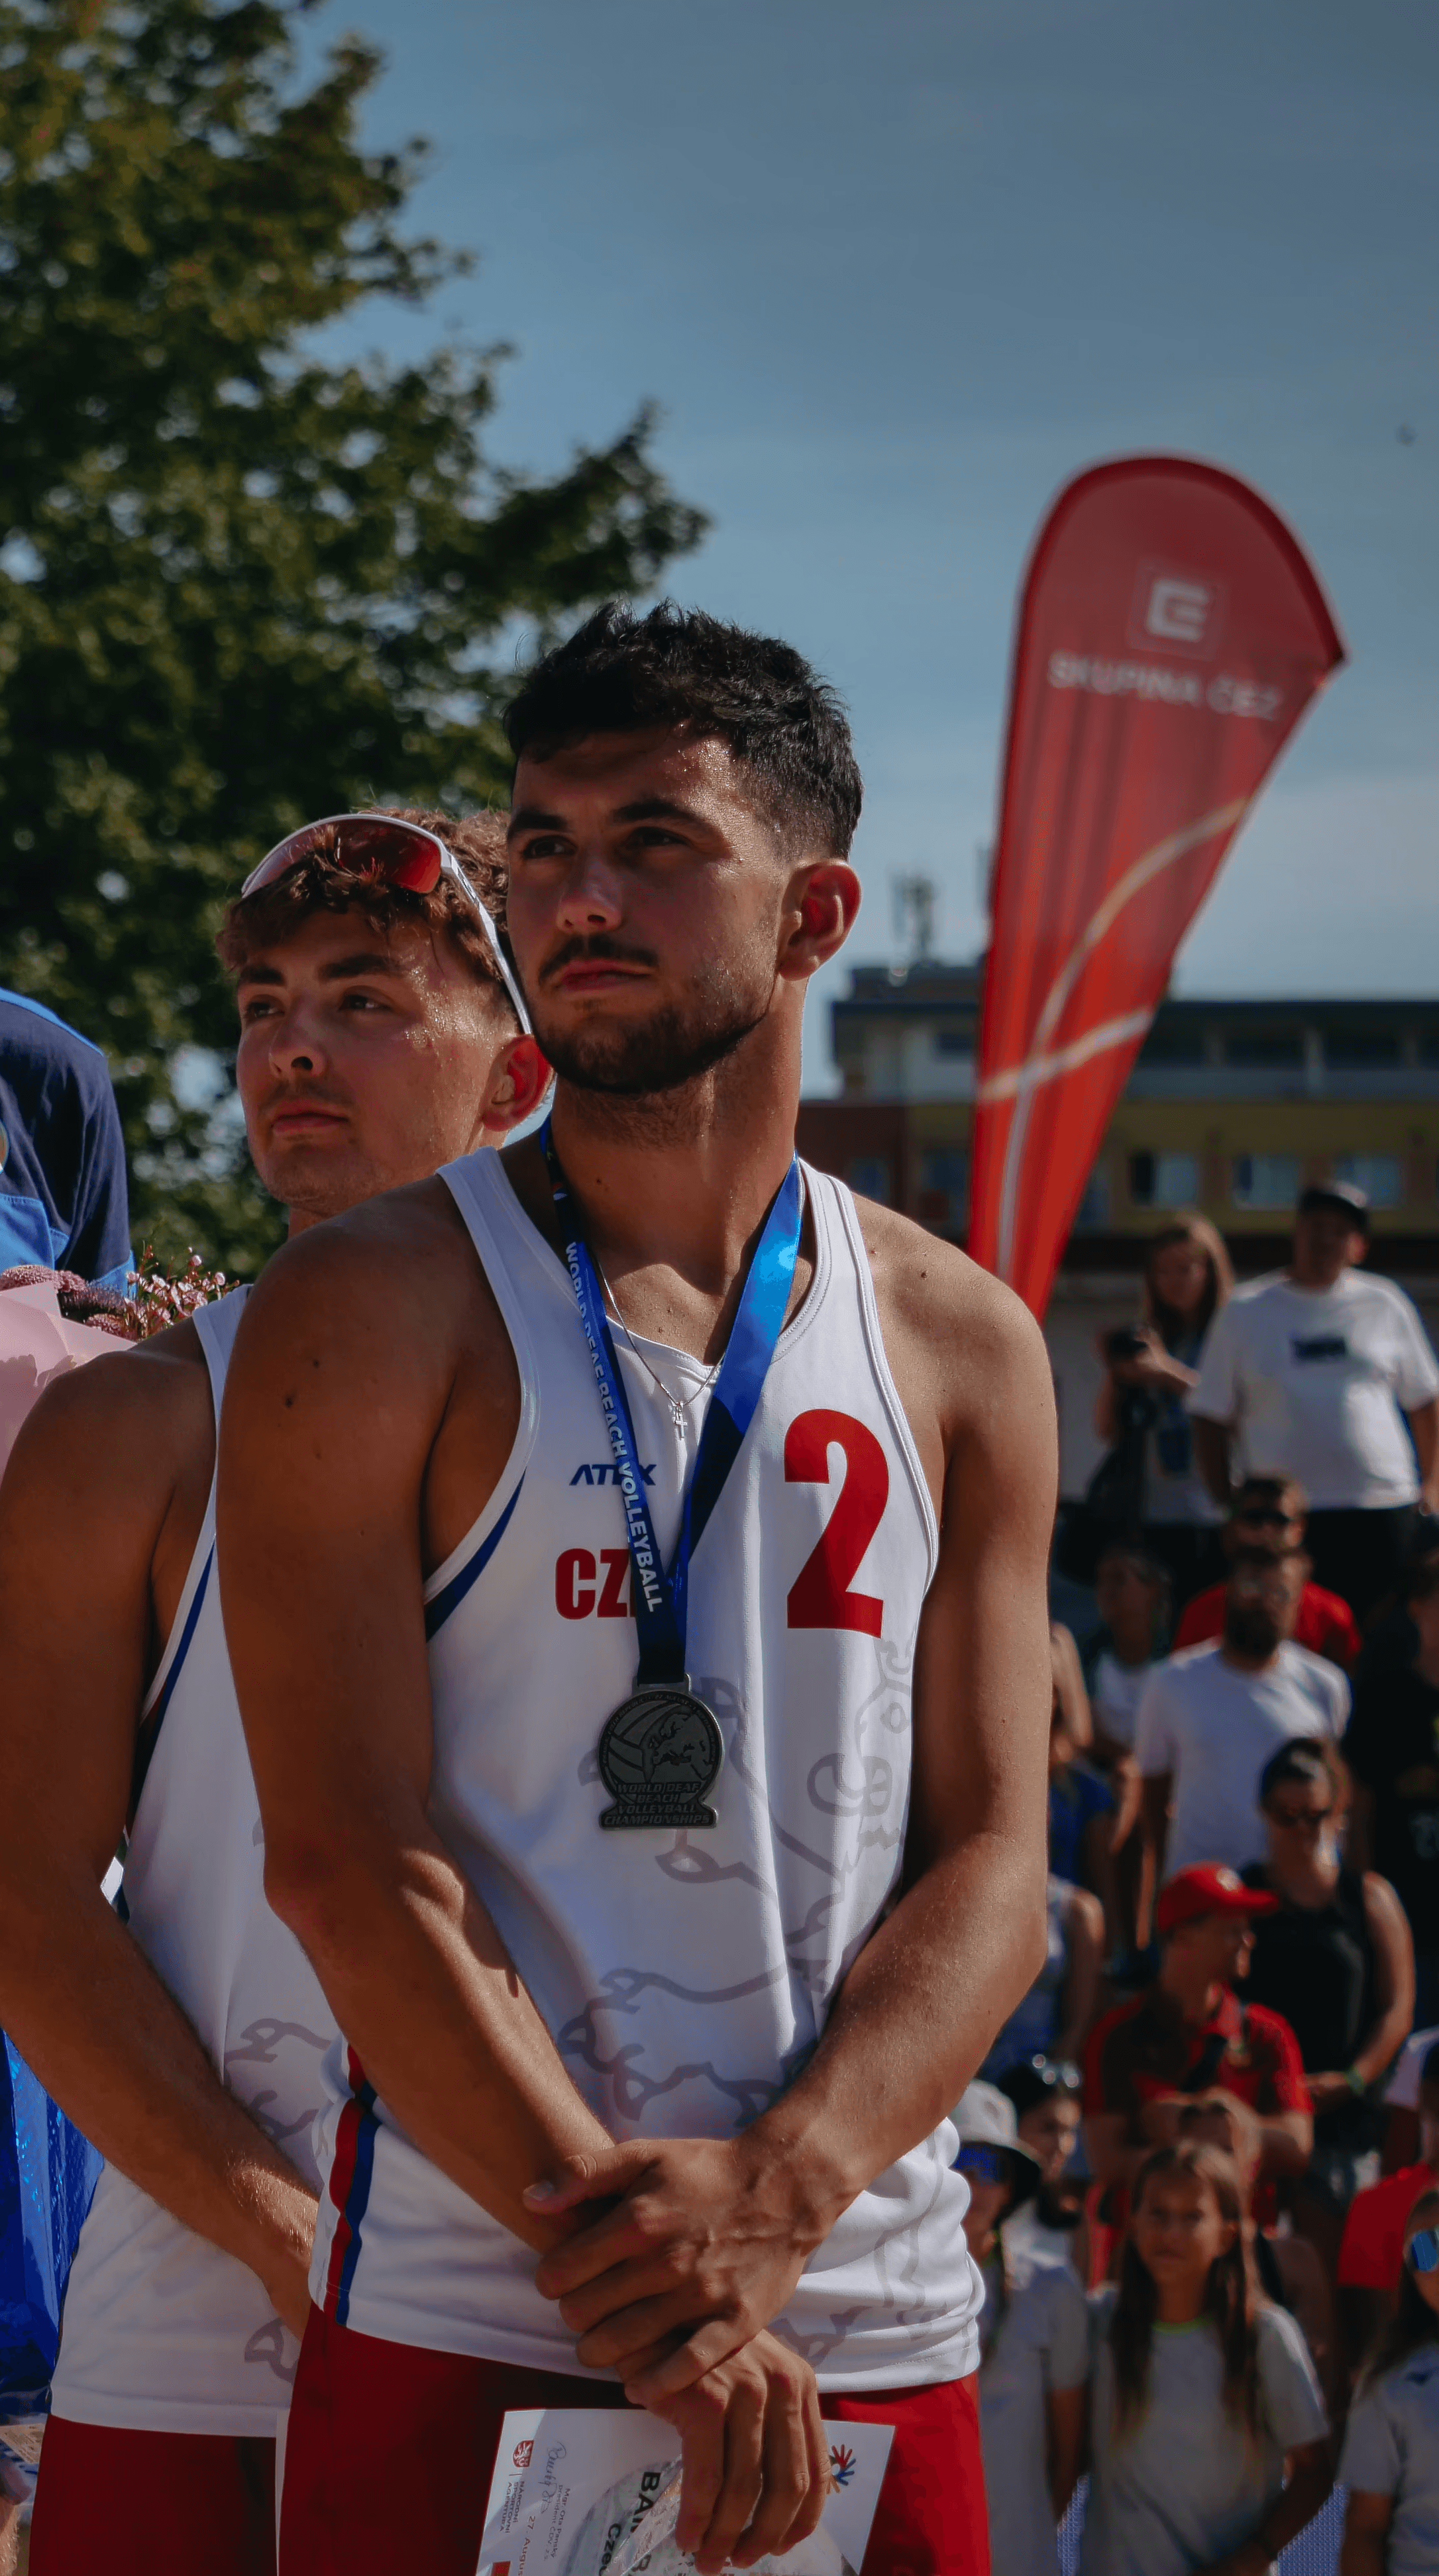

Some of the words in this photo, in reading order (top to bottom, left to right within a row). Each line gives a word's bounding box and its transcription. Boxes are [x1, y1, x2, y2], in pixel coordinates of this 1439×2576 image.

[784, 1409, 889, 1638] 2
[617, 1461, 665, 1613] VOLLEYBALL
[555, 1548, 635, 1619] CZ
[617, 1783, 663, 1793] WORLD
[666, 1783, 700, 1793] DEAF
[637, 1794, 679, 1803] BEACH
[617, 1803, 696, 1814] VOLLEYBALL
[604, 1815, 710, 1825] CHAMPIONSHIPS
